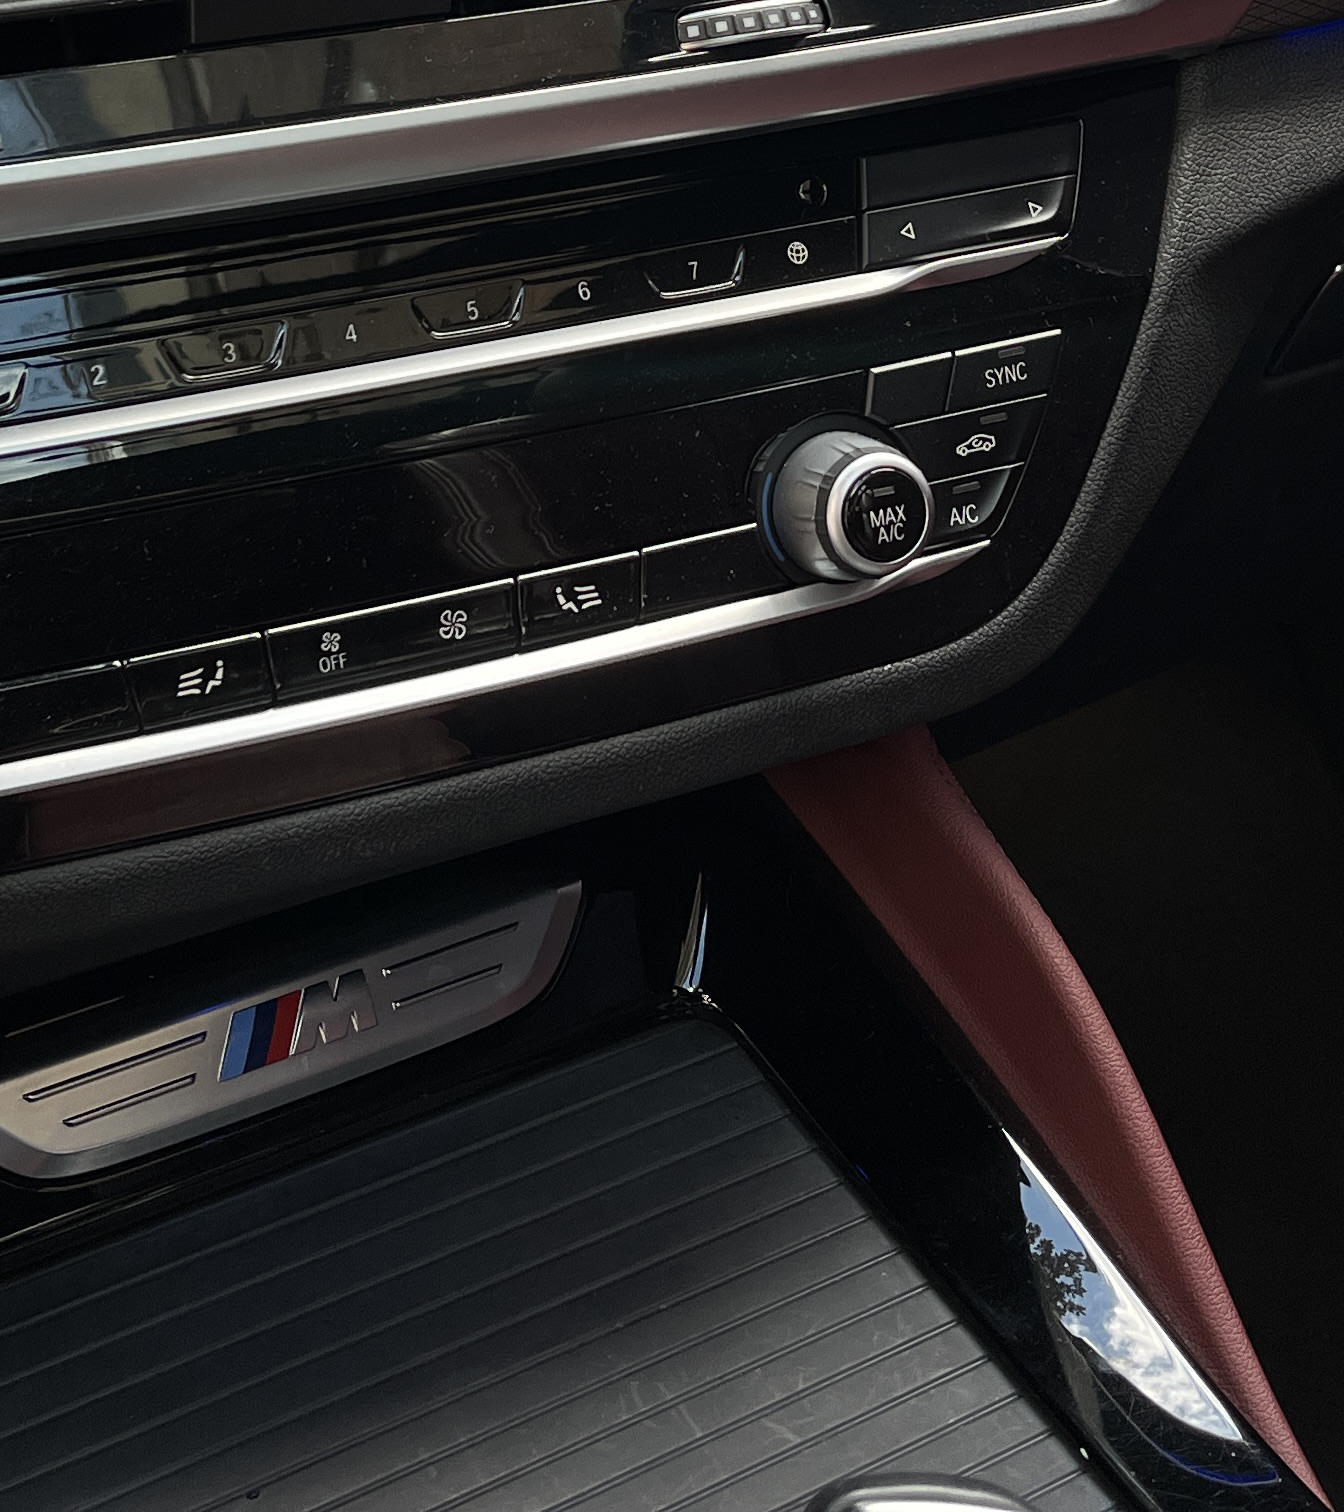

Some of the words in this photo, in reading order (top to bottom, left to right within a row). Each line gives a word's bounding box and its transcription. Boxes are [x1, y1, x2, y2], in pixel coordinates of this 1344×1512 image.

[688, 261, 698, 281] 7
[578, 281, 591, 301] 6
[466, 301, 479, 321] 5
[345, 324, 358, 344] 4
[222, 342, 237, 363] 3
[90, 365, 108, 386] 2
[984, 361, 1028, 389] SYNC
[869, 504, 906, 529] MAX
[950, 503, 979, 527] A/C
[877, 522, 905, 545] A/C
[319, 651, 348, 674] OFF
